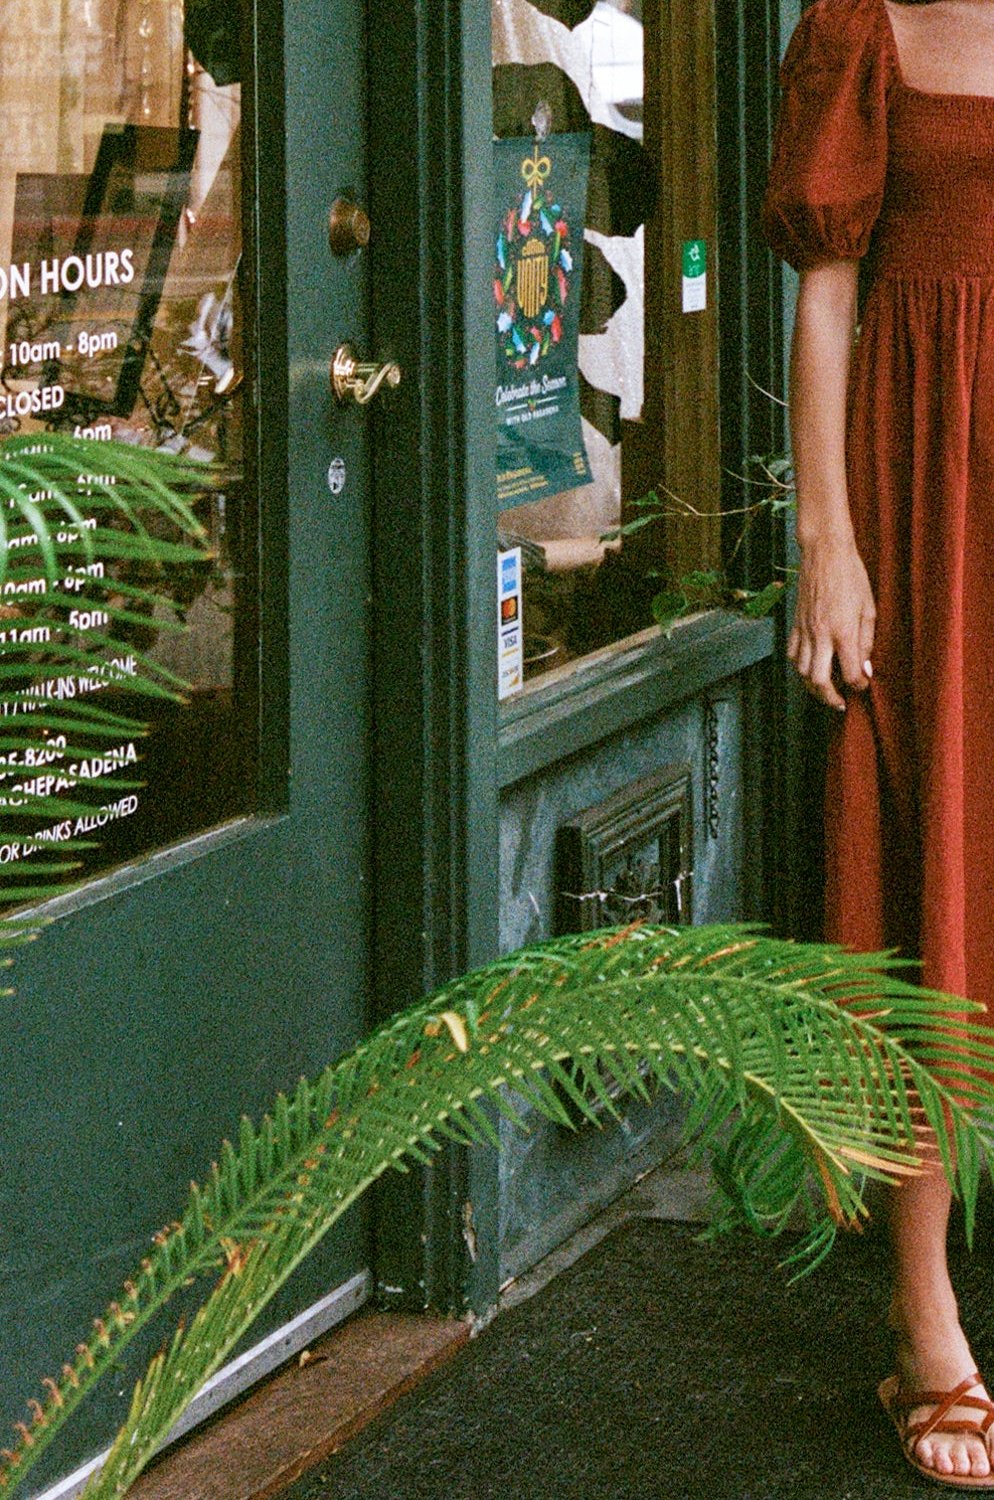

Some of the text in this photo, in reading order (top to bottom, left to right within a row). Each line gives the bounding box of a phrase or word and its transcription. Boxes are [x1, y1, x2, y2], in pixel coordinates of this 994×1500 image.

[41, 249, 134, 295] HOURS
[10, 341, 61, 366] 10am
[78, 331, 118, 358] 8pm
[0, 579, 47, 598] 0am
[22, 819, 72, 857] DRINKS
[73, 794, 139, 837] ALLOWED
